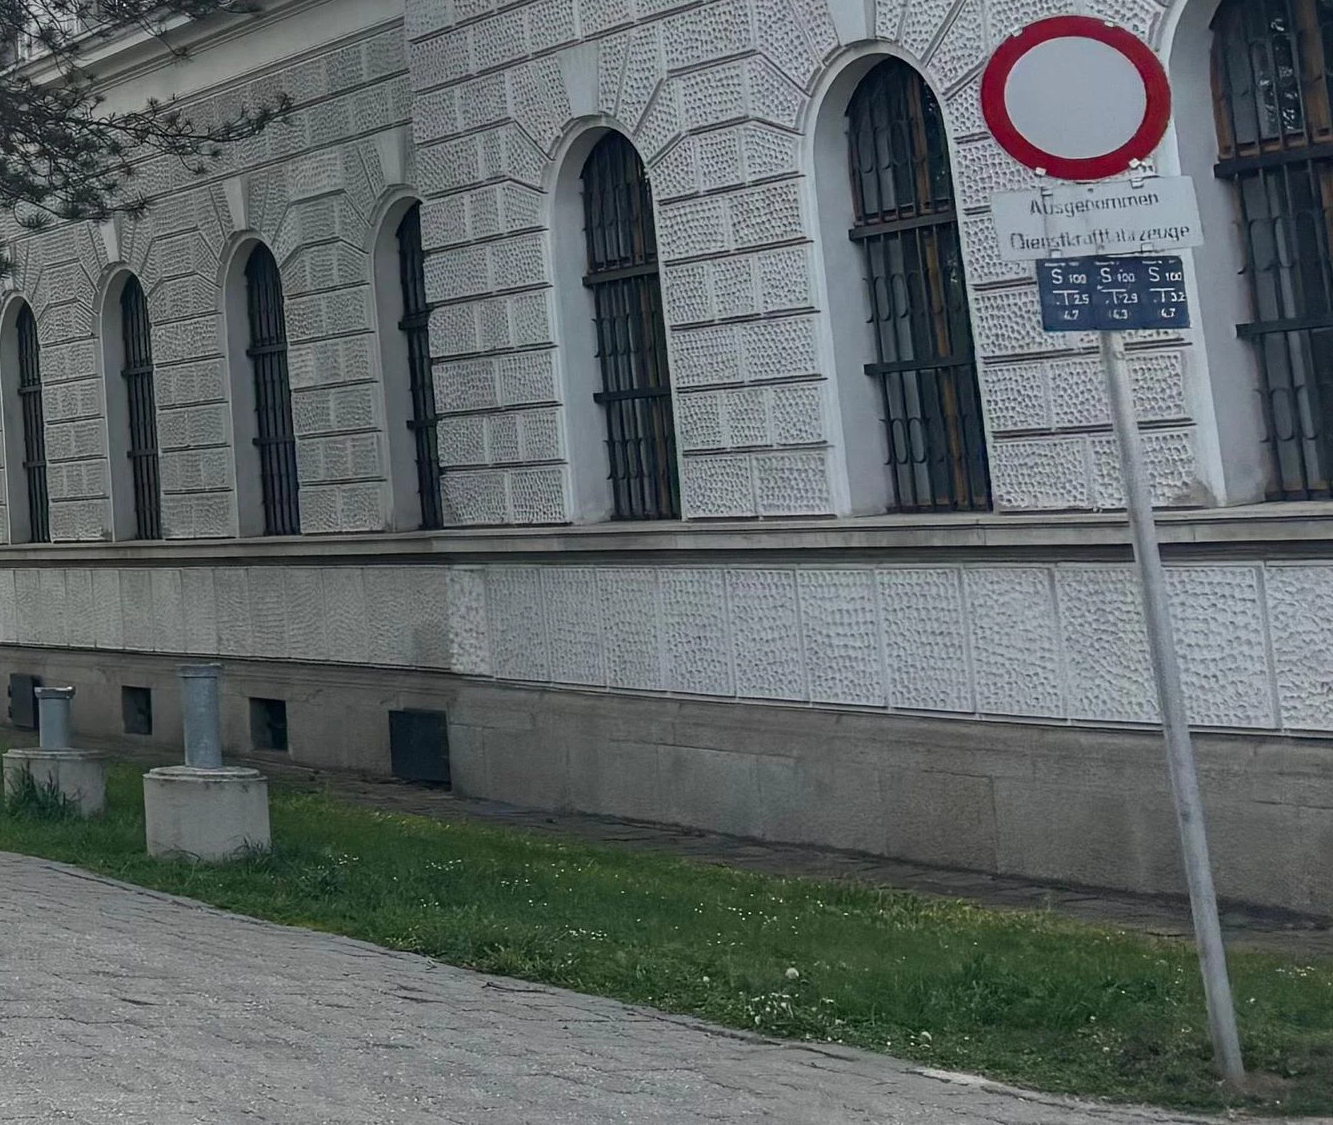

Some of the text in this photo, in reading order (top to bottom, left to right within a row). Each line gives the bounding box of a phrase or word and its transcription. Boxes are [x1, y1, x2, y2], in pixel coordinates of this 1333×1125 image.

[1051, 269, 1063, 284] S
[1100, 268, 1112, 283] S
[1148, 267, 1160, 281] S
